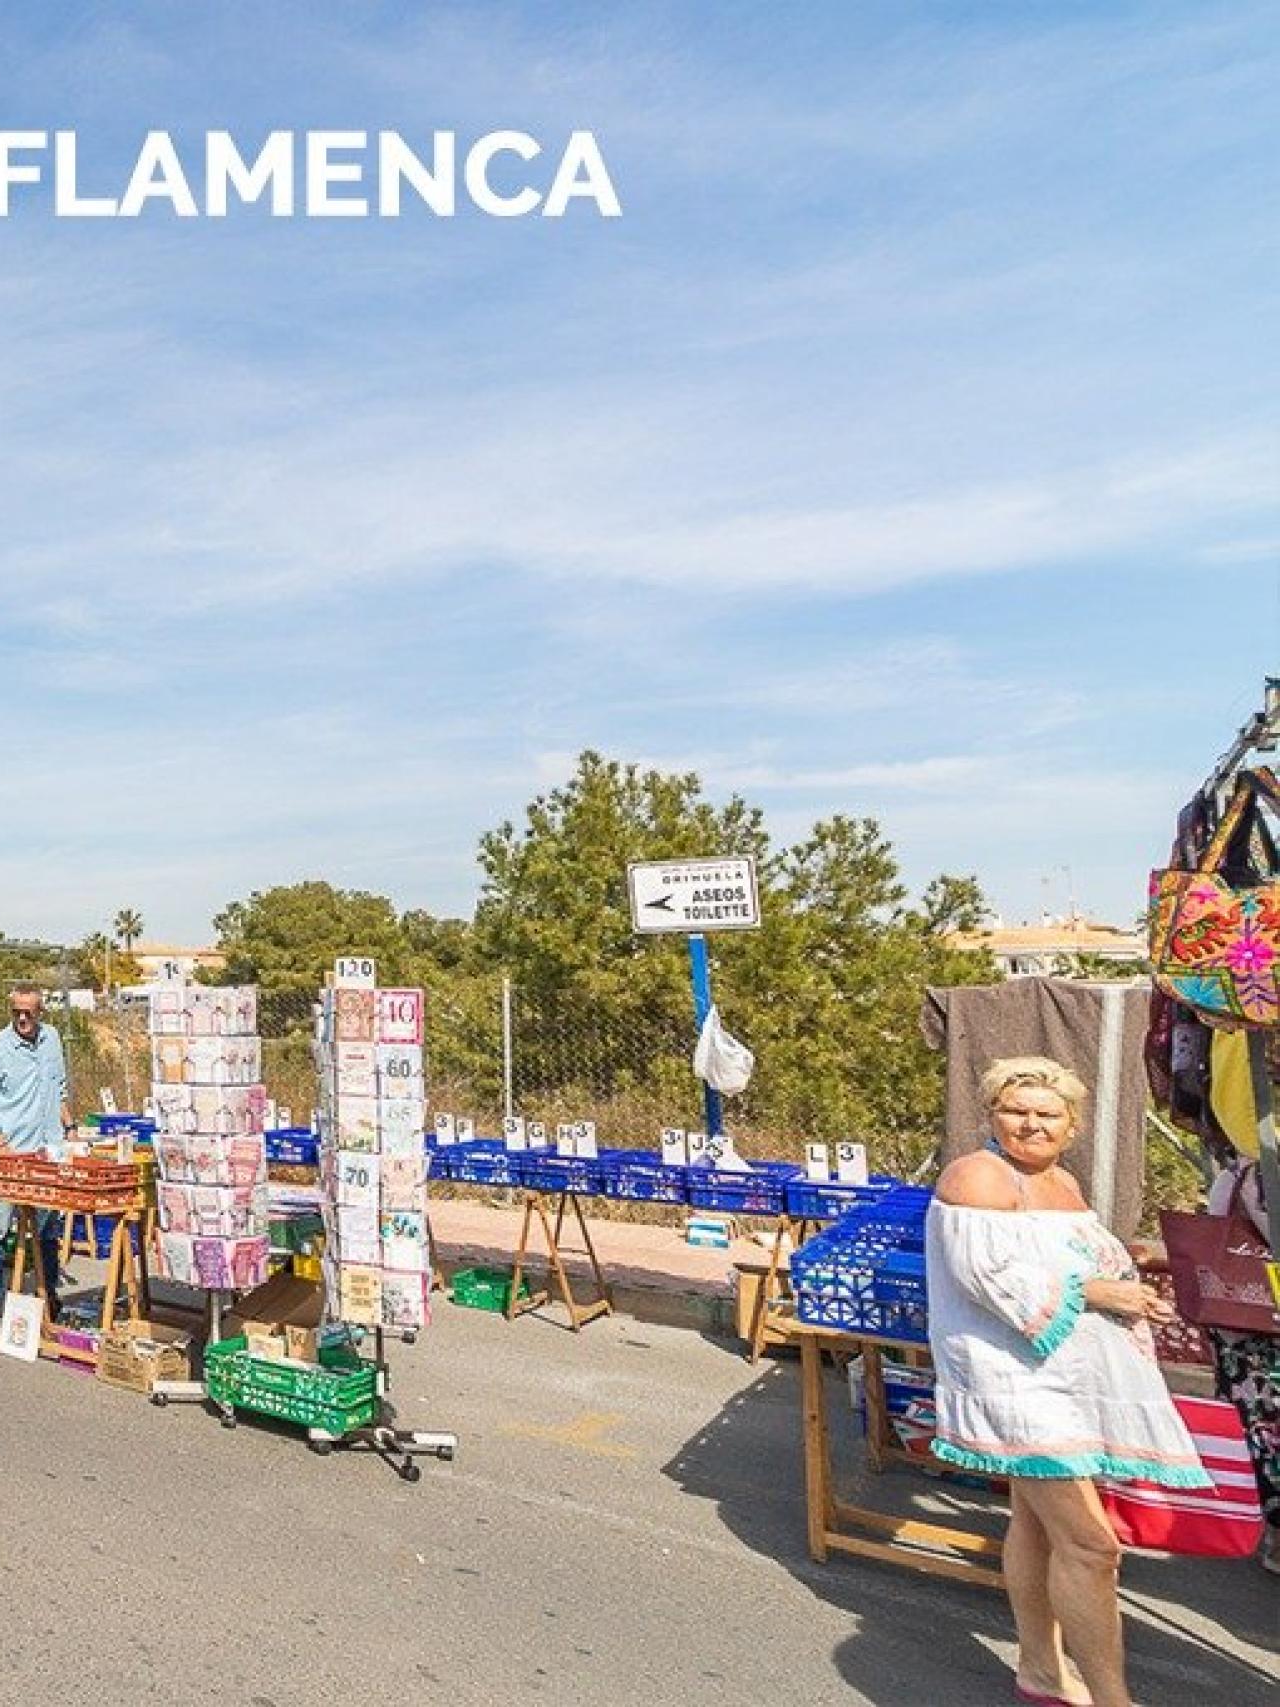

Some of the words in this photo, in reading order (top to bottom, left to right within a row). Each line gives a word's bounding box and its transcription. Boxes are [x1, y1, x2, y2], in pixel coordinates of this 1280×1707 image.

[692, 885, 746, 903] ASEOS
[683, 903, 750, 920] TOILETTE
[386, 1058, 411, 1078] 60
[345, 1166, 370, 1188] 70
